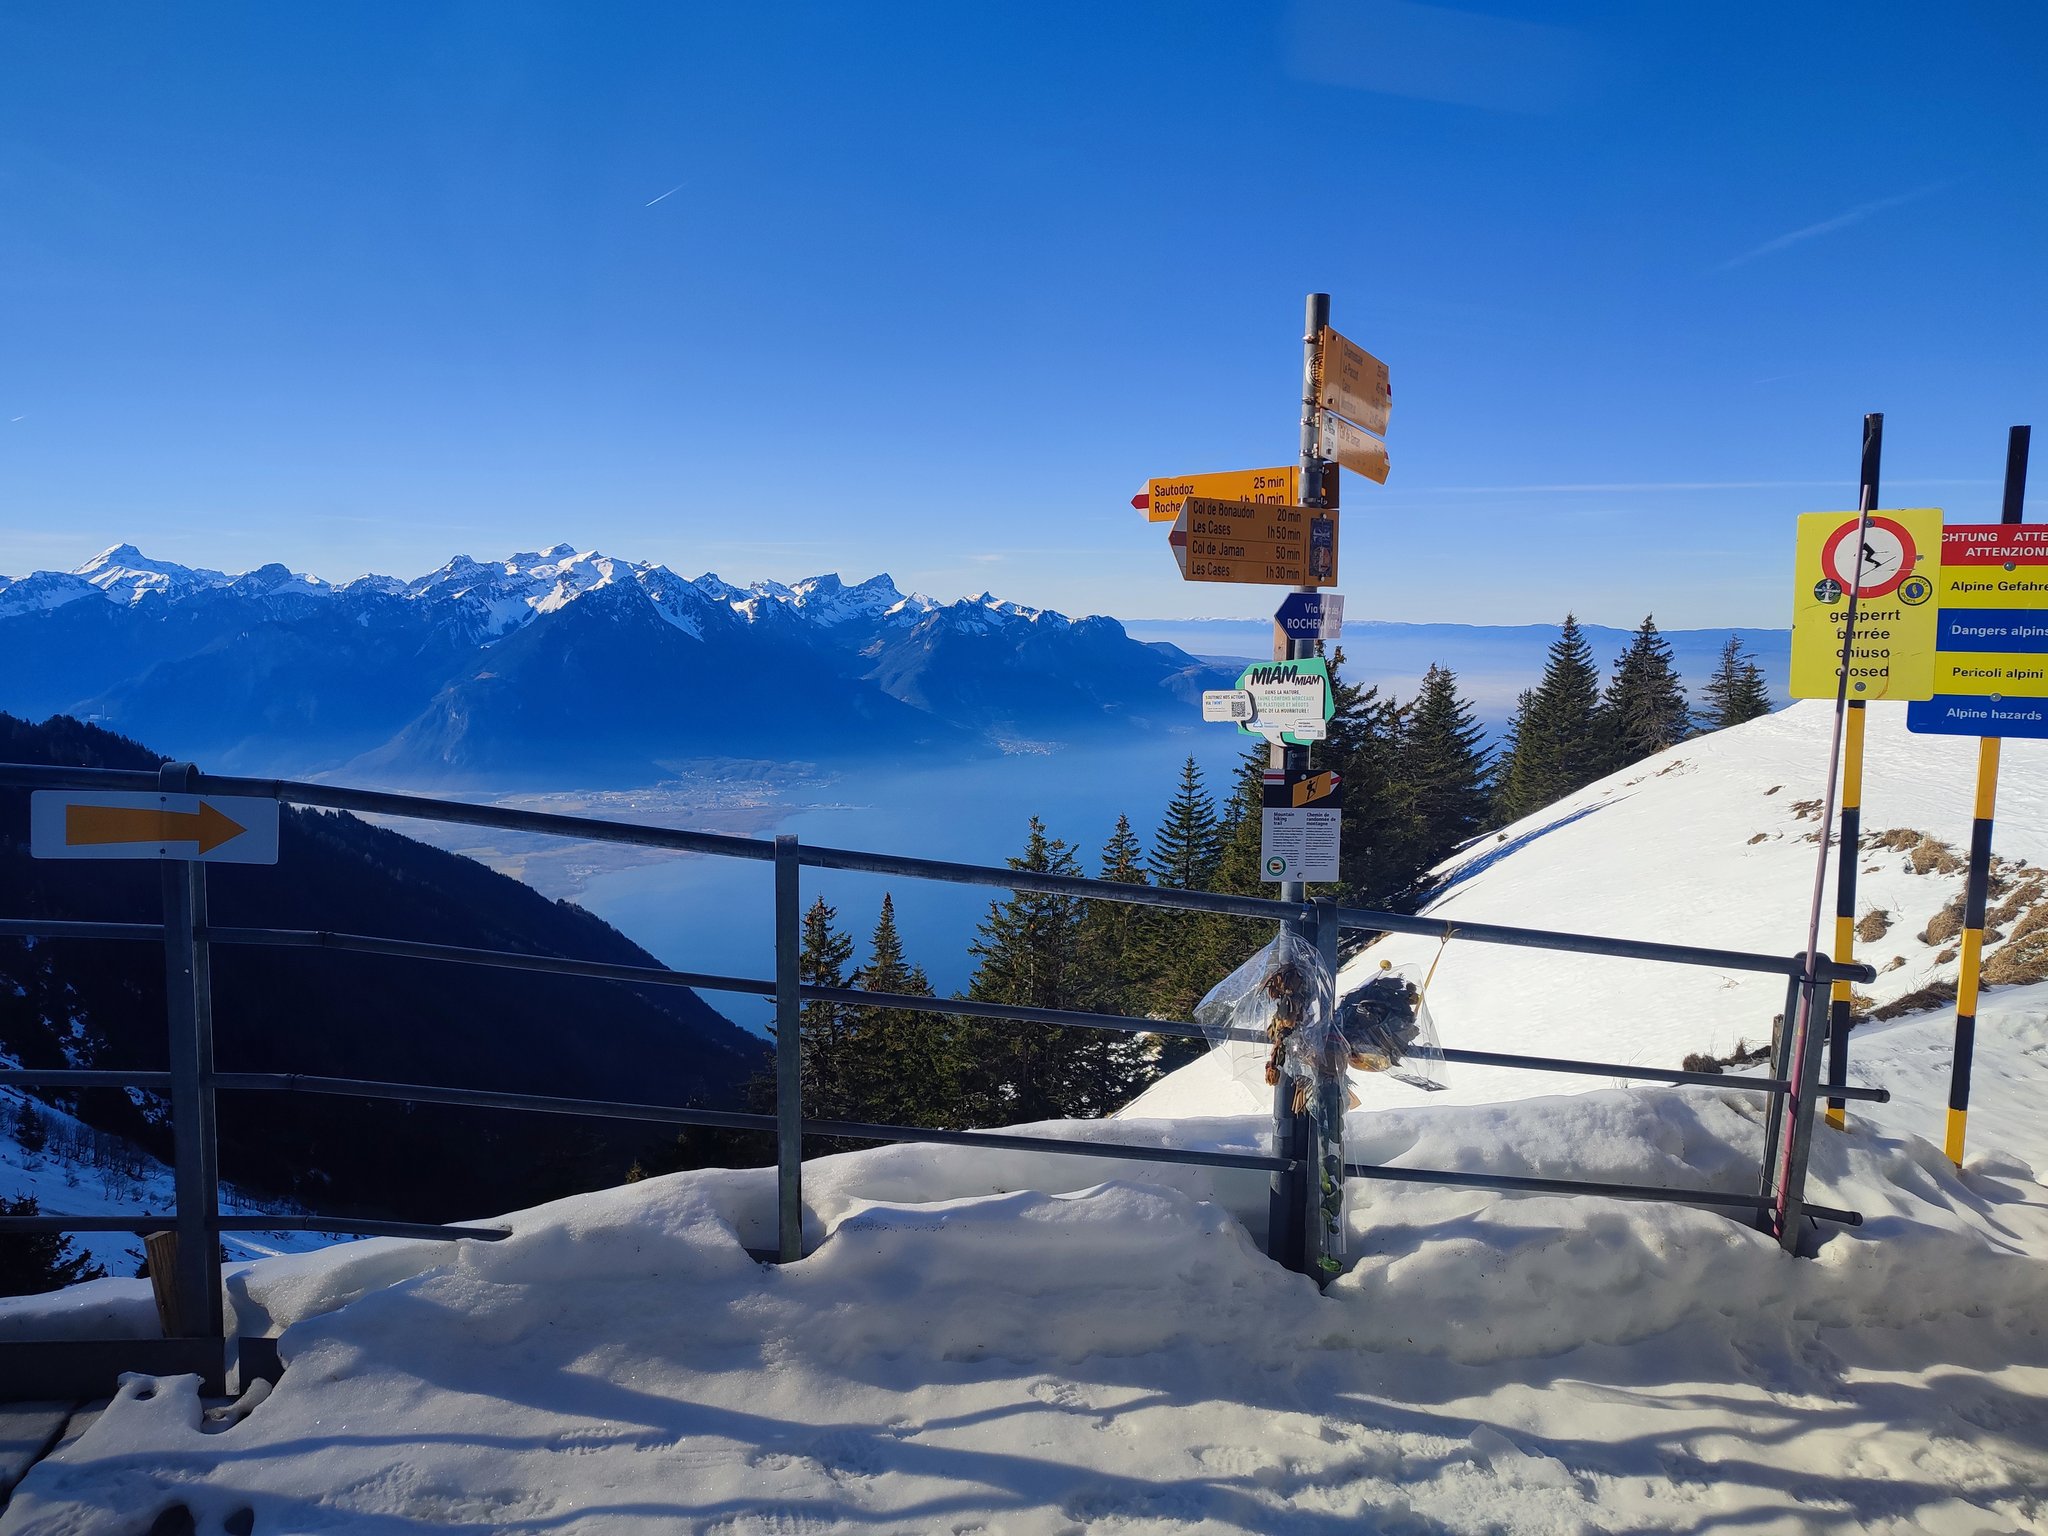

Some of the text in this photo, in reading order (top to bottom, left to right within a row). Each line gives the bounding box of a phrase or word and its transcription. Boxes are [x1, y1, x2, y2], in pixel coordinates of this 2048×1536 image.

[1155, 476, 1284, 497] Sautodoz 25 min
[1155, 500, 1182, 513] Roche
[1255, 493, 1264, 505] 10
[1267, 492, 1284, 505] min
[1194, 501, 1301, 522] Col de Bonaudon 20 min
[1193, 519, 1206, 533] Les
[1208, 520, 1231, 535] Cases
[1288, 528, 1300, 540] min
[1942, 532, 1998, 542] CHTUNG
[1192, 540, 1300, 560] Col de Jaman 50 min
[1965, 547, 2048, 557] ATTENZION
[1192, 561, 1205, 575] Les
[1207, 562, 1230, 576] Cases
[1287, 568, 1299, 580] min
[1951, 581, 1993, 593] Alpine
[1304, 602, 1318, 614] Via
[1951, 625, 2048, 638] Dangers alpins
[1251, 665, 1320, 686] MIAM MIAM
[1835, 666, 1888, 677] cosed
[1952, 667, 2043, 680] Pericoli alpini
[1946, 708, 2042, 721] Alpine hazards
